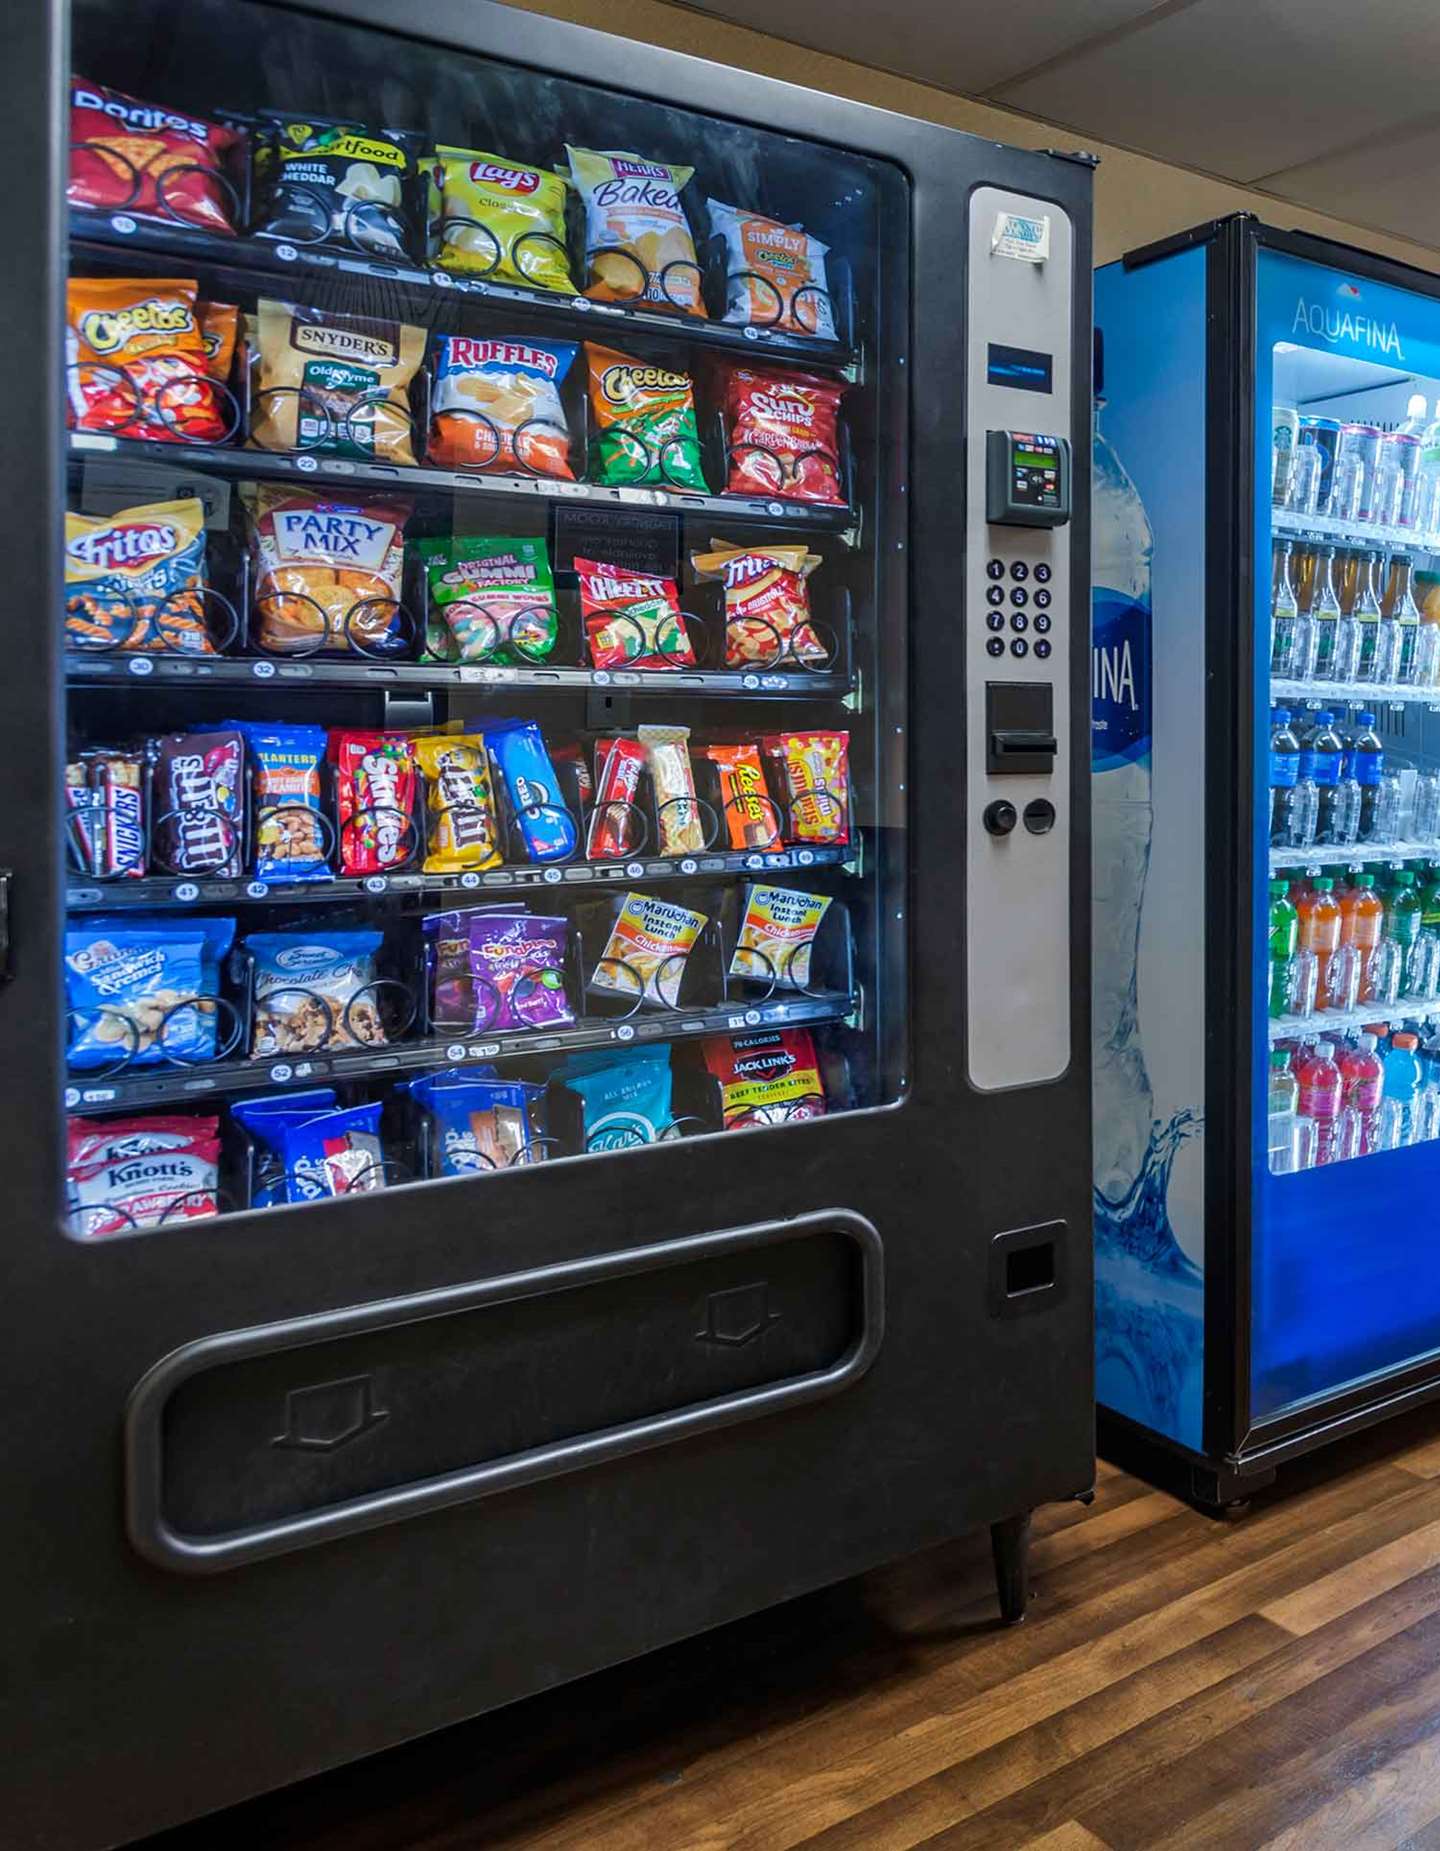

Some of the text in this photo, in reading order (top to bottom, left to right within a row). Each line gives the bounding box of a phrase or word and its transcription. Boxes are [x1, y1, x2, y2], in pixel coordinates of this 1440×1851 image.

[74, 90, 210, 140] Doritos
[285, 163, 329, 174] WHITE
[282, 172, 336, 186] HEDDAR
[747, 231, 801, 251] SIMPLY
[82, 301, 191, 353] Cheetos
[1292, 298, 1405, 361] AQUAFINA
[301, 328, 389, 357] SNYDER'S
[449, 336, 558, 378] RUFFLES
[310, 366, 334, 378] Old
[750, 391, 815, 420] Sun
[773, 410, 813, 427] CHIPS
[285, 514, 384, 542] PARTY
[67, 522, 178, 568] Fritos
[303, 533, 361, 557] MIX
[457, 554, 518, 571] ORIGINAL
[721, 554, 778, 589] Frit
[442, 565, 537, 585] GUMMI
[477, 578, 530, 590] FACTORY
[516, 776, 541, 820] OREO
[768, 891, 823, 910] Maruchan
[770, 903, 808, 918] Instant
[642, 914, 683, 933] Instant
[643, 901, 700, 928] Maruchan
[772, 912, 803, 924] Lunch
[644, 923, 677, 940] Lunch
[635, 934, 679, 954] Chick
[743, 1035, 781, 1047] CALORIES
[733, 1061, 762, 1075] JACK
[729, 1088, 751, 1100] BEEF
[108, 1160, 194, 1189] Knott's
